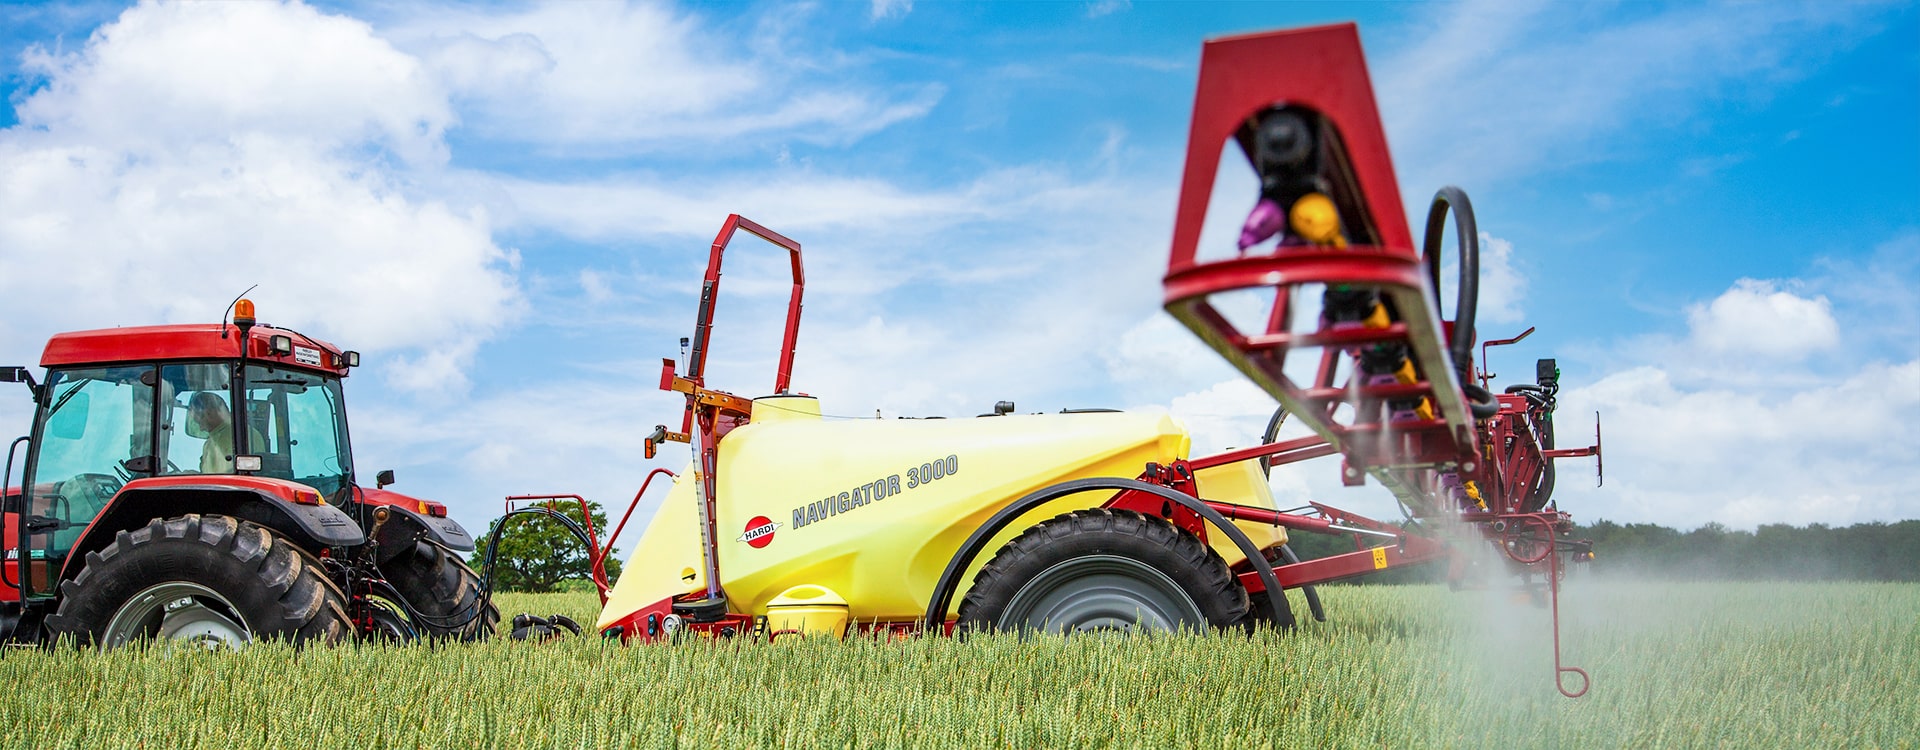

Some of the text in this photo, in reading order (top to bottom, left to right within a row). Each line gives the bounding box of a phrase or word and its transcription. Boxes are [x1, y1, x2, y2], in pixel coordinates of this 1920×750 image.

[792, 454, 958, 530] NAVIGATOR 3000
[745, 524, 775, 540] HARDI
